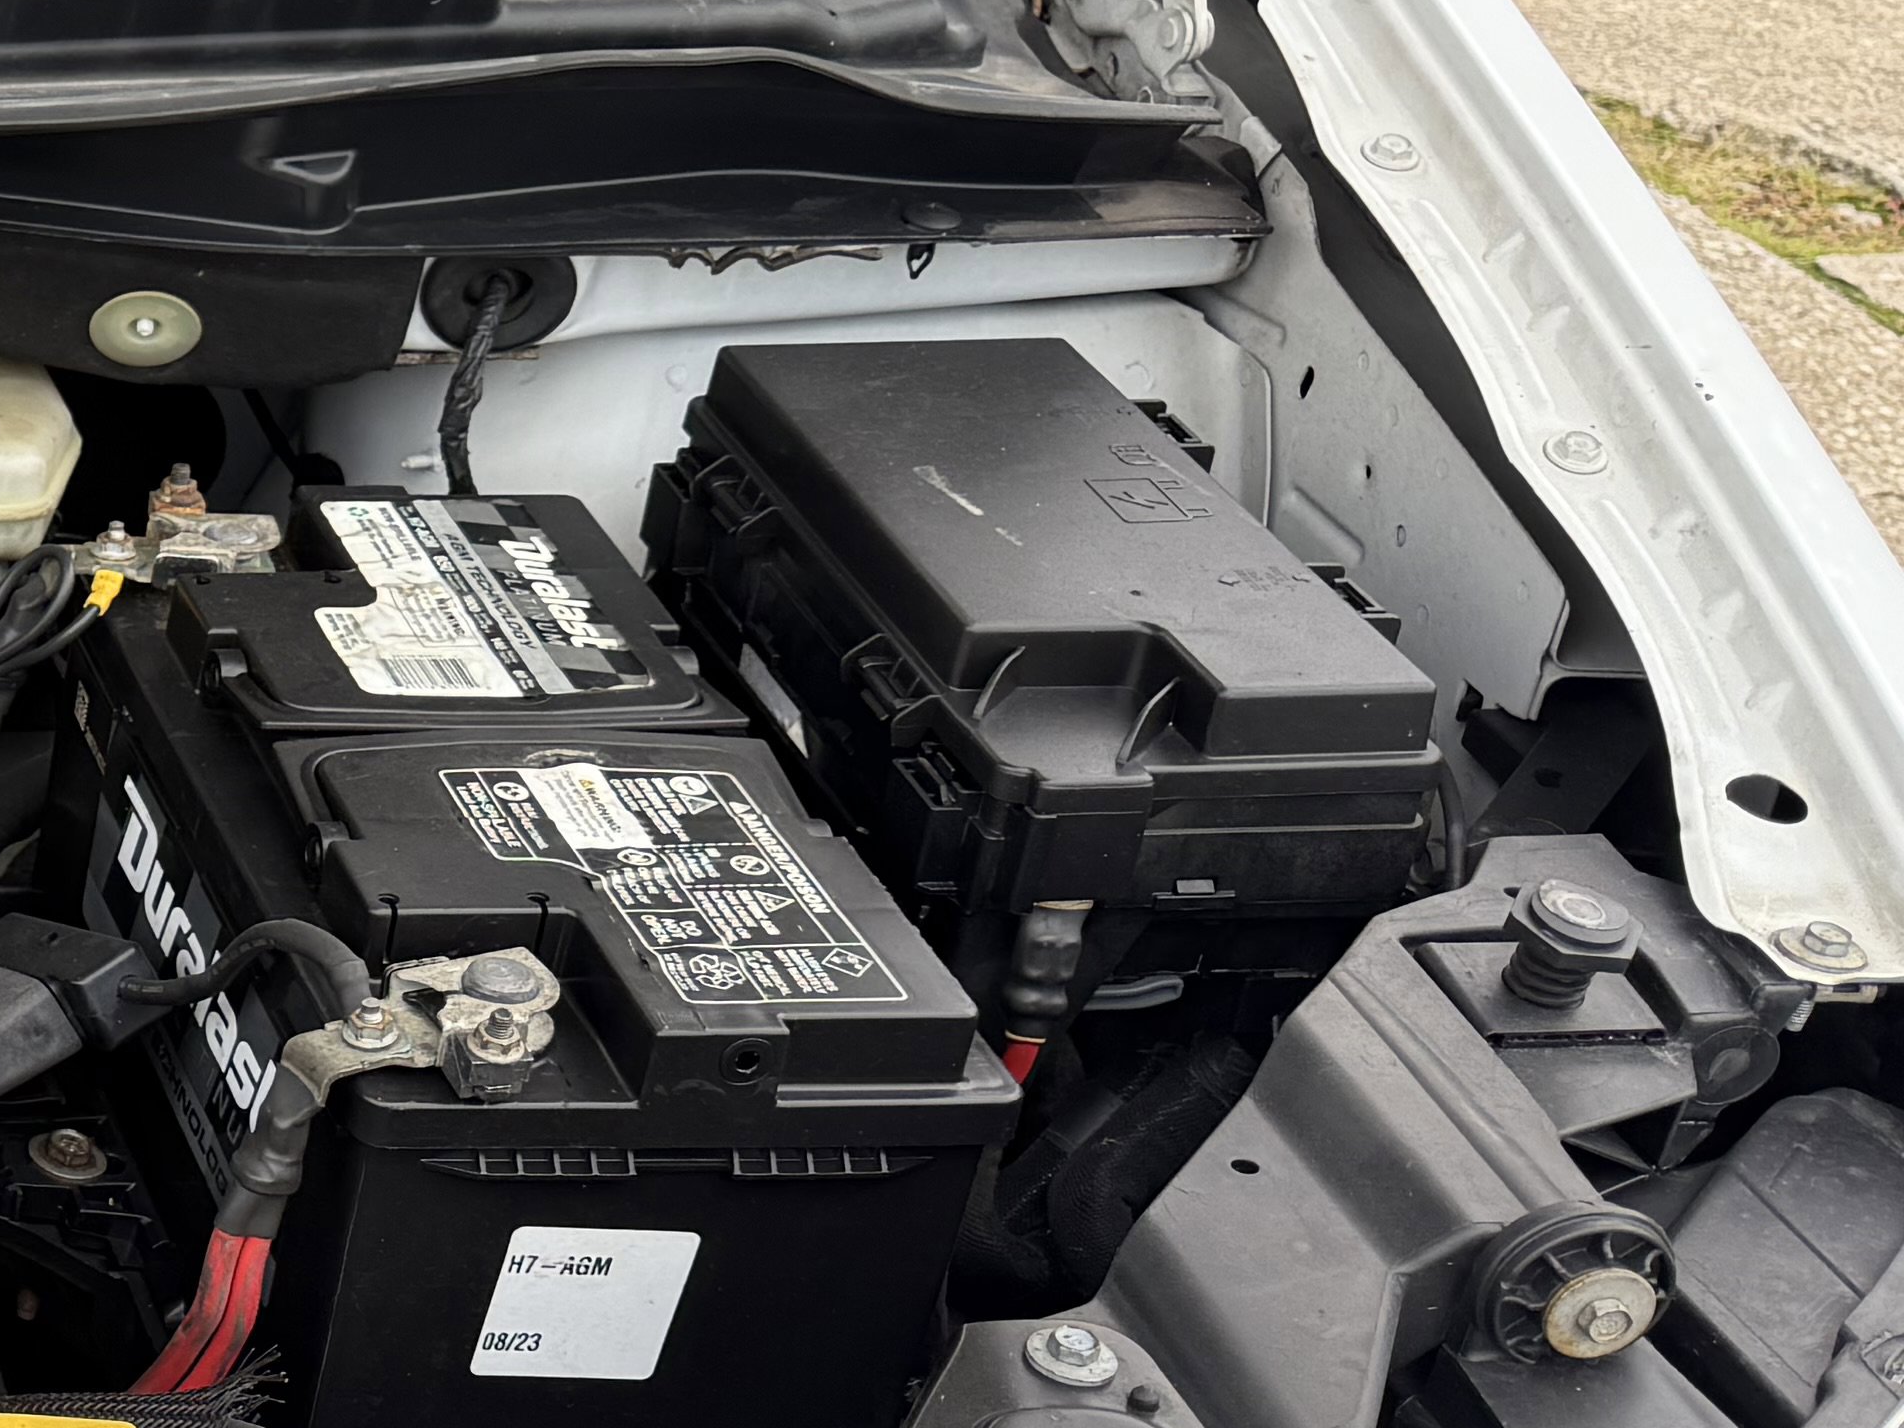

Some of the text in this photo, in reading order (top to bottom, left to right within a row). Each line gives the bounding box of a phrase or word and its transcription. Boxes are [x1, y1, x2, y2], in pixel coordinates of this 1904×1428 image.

[497, 536, 620, 649] Duralast
[496, 569, 567, 645] PLATINUM
[656, 917, 691, 940] NOT
[676, 919, 706, 937] DO
[482, 1332, 542, 1351] 08/23
